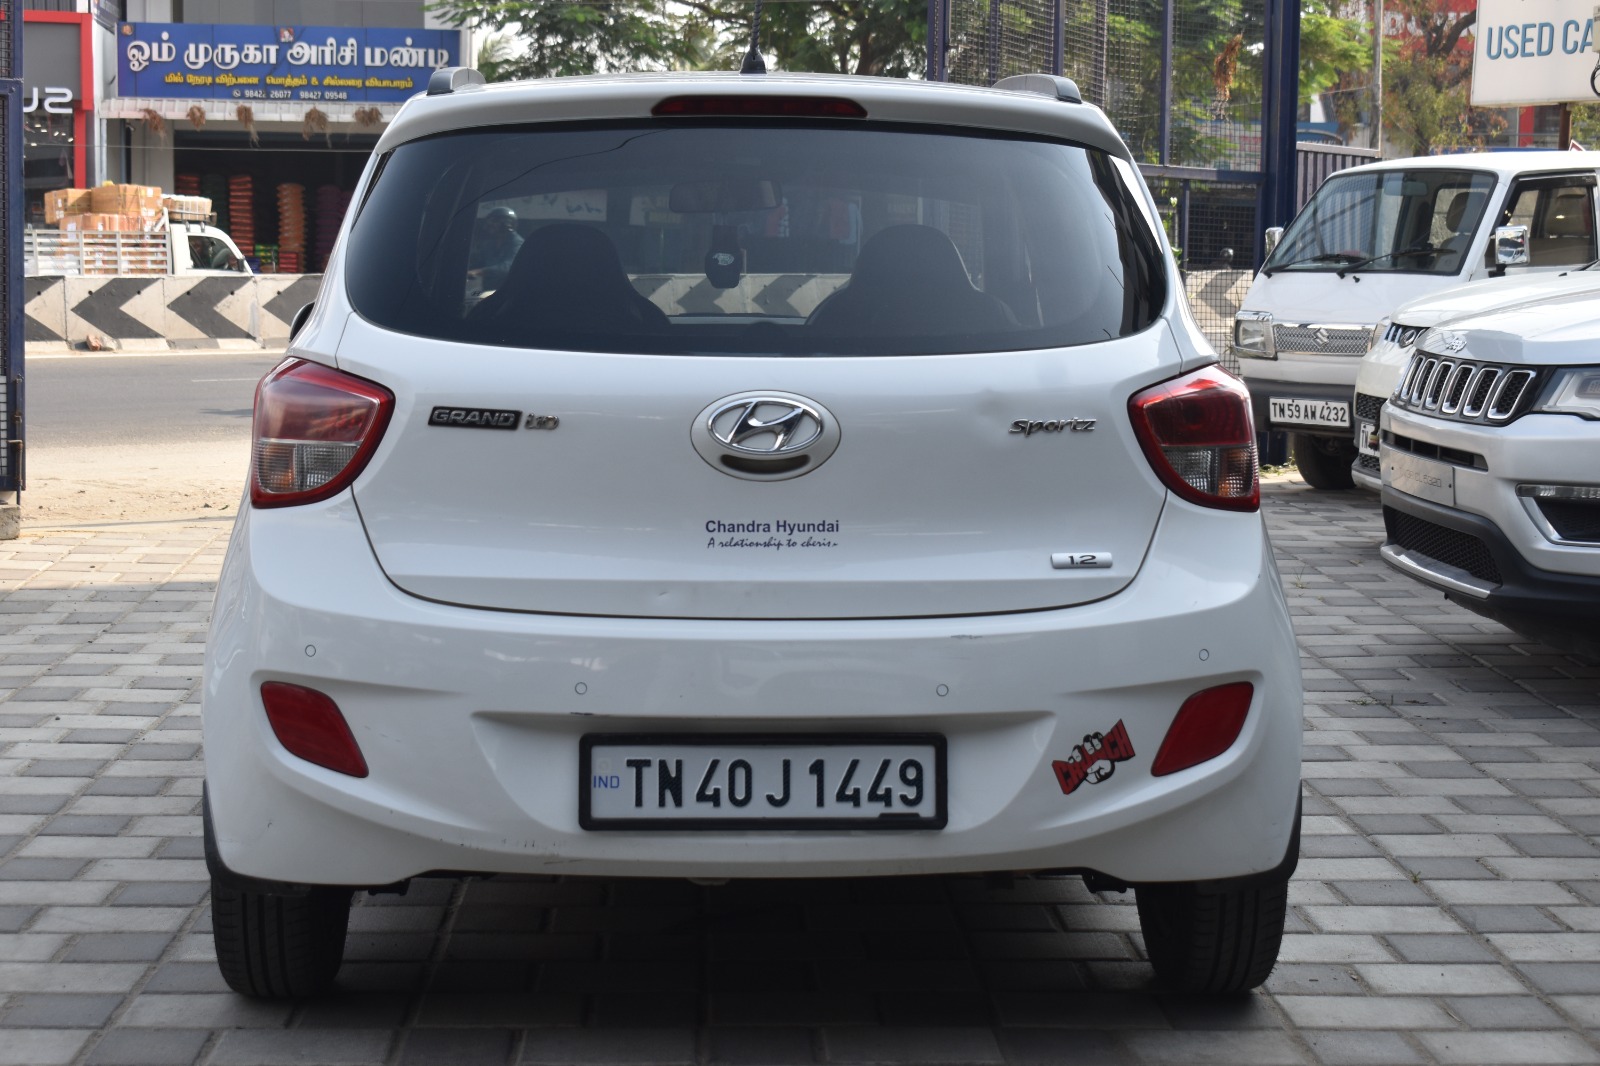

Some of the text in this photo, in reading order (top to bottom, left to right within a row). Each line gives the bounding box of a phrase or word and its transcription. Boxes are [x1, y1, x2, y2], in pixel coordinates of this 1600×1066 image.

[1486, 22, 1555, 60] USED
[127, 31, 449, 72] ஓம் முருகா அரிசி மண்டி
[431, 408, 516, 427] GRAND
[1271, 402, 1285, 418] TN
[1287, 403, 1301, 419] 59
[1319, 405, 1347, 422] 4232
[705, 519, 840, 536] Chandra Hyundai
[707, 537, 716, 549] A
[718, 536, 784, 551] relationship
[786, 538, 798, 548] to
[593, 775, 620, 789] IND
[626, 758, 924, 808] TN 40 J 1449
